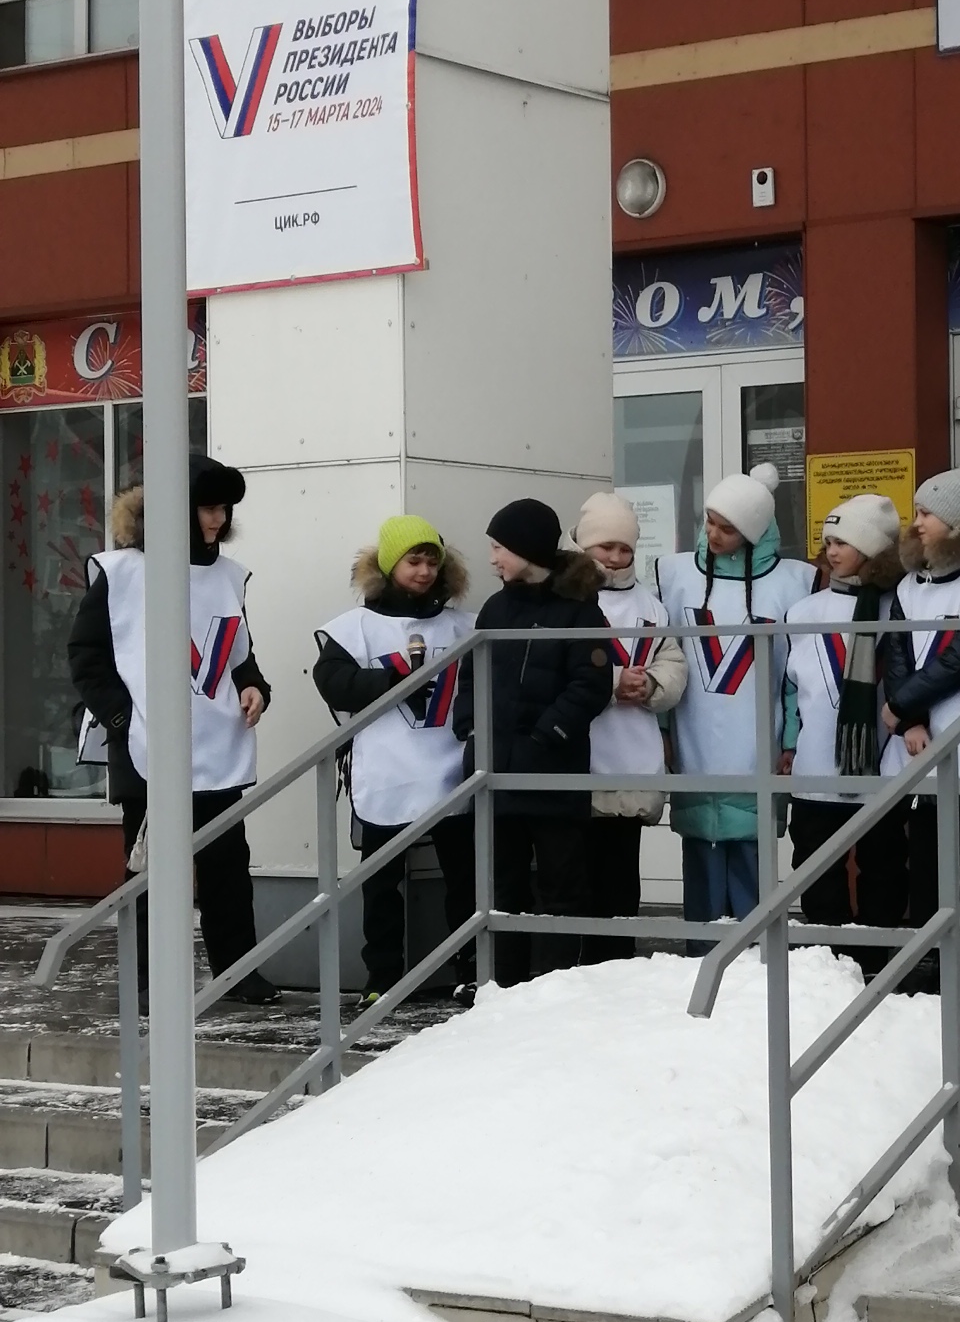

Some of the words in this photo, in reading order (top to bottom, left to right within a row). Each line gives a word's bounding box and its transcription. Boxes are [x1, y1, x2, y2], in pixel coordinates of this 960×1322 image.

[292, 5, 376, 42] ВЫБОРЫ
[282, 31, 398, 73] ПРЕЗИДЕНТА
[273, 72, 350, 105] РОССИИ
[305, 101, 350, 127] МАРТА
[352, 95, 383, 119] 2024
[613, 272, 804, 330] ом,
[73, 321, 118, 380] С
